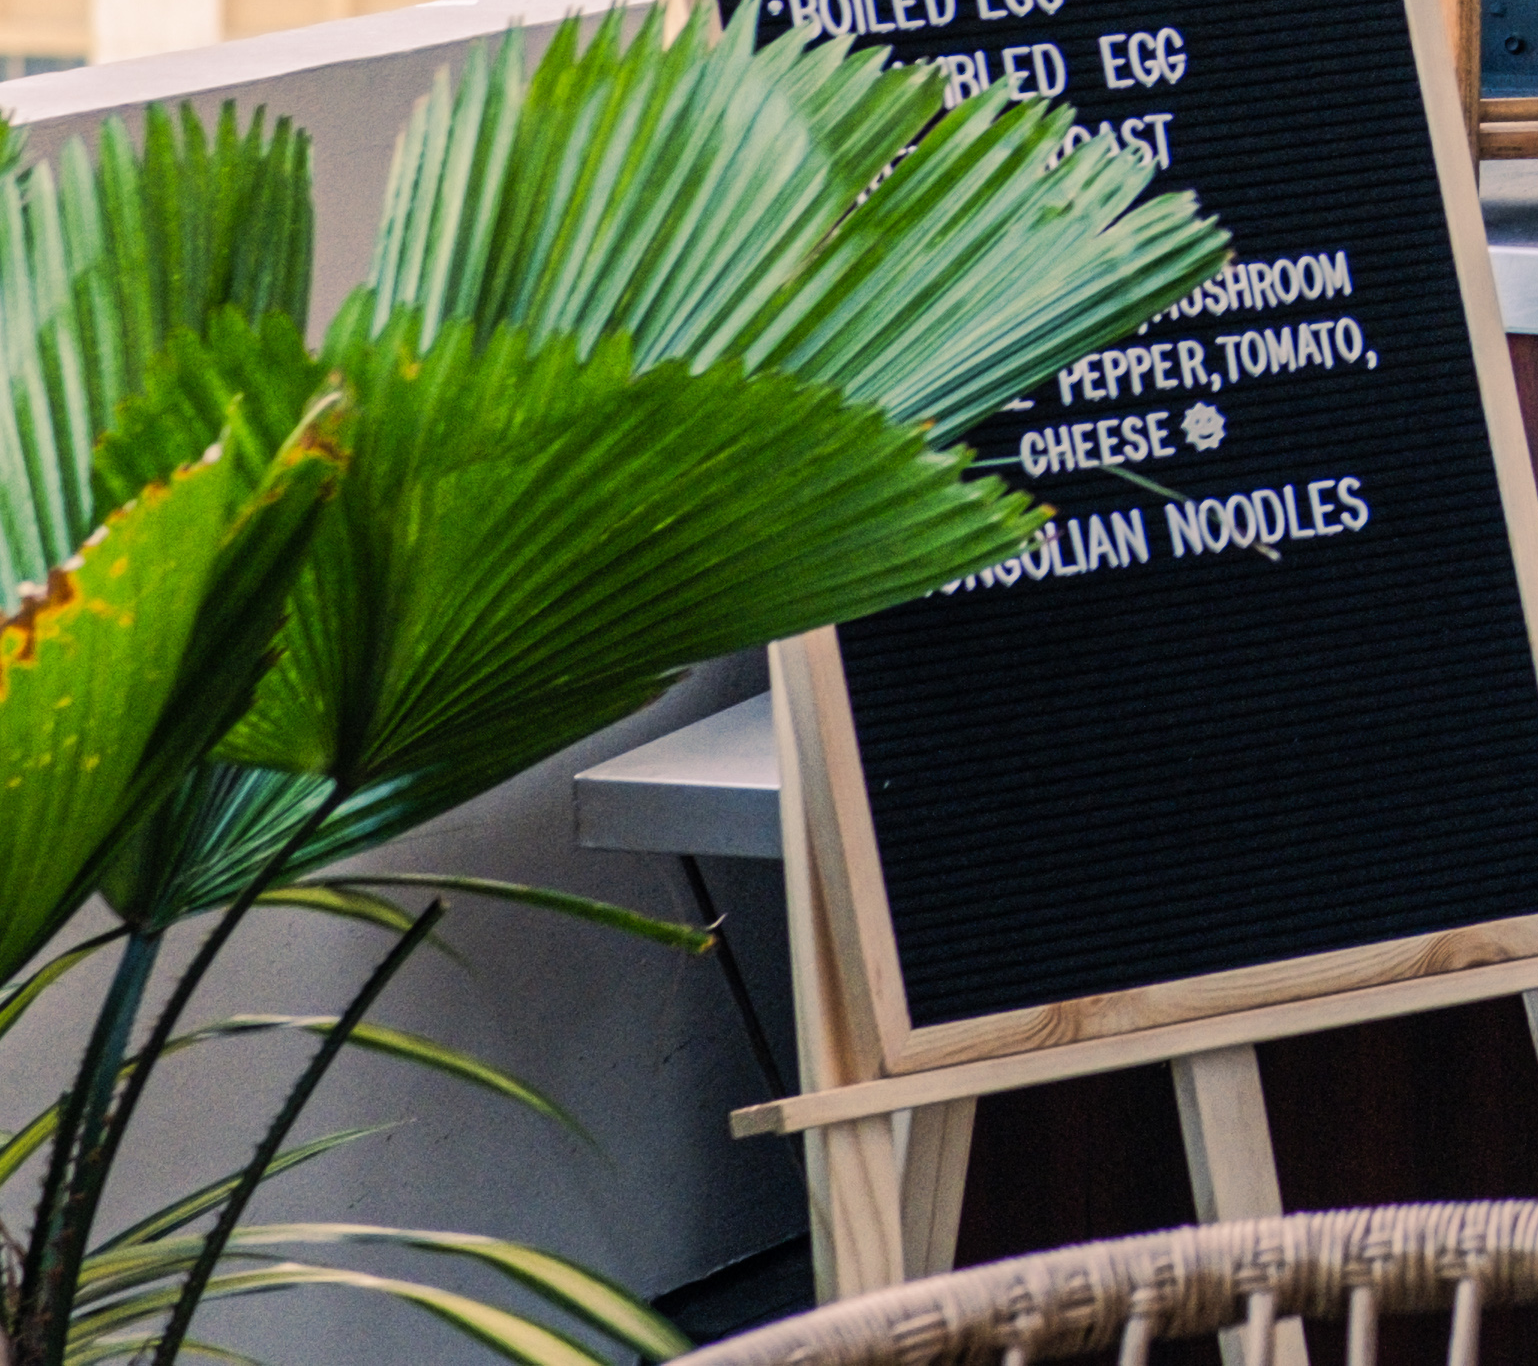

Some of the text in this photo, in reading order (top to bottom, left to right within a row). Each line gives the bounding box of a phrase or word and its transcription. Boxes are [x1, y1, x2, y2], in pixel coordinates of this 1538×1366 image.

[1098, 27, 1188, 90] EGG
[1047, 112, 1175, 171] OAST
[1020, 411, 1176, 478] CHEESE
[1165, 477, 1369, 558] NOODLES
